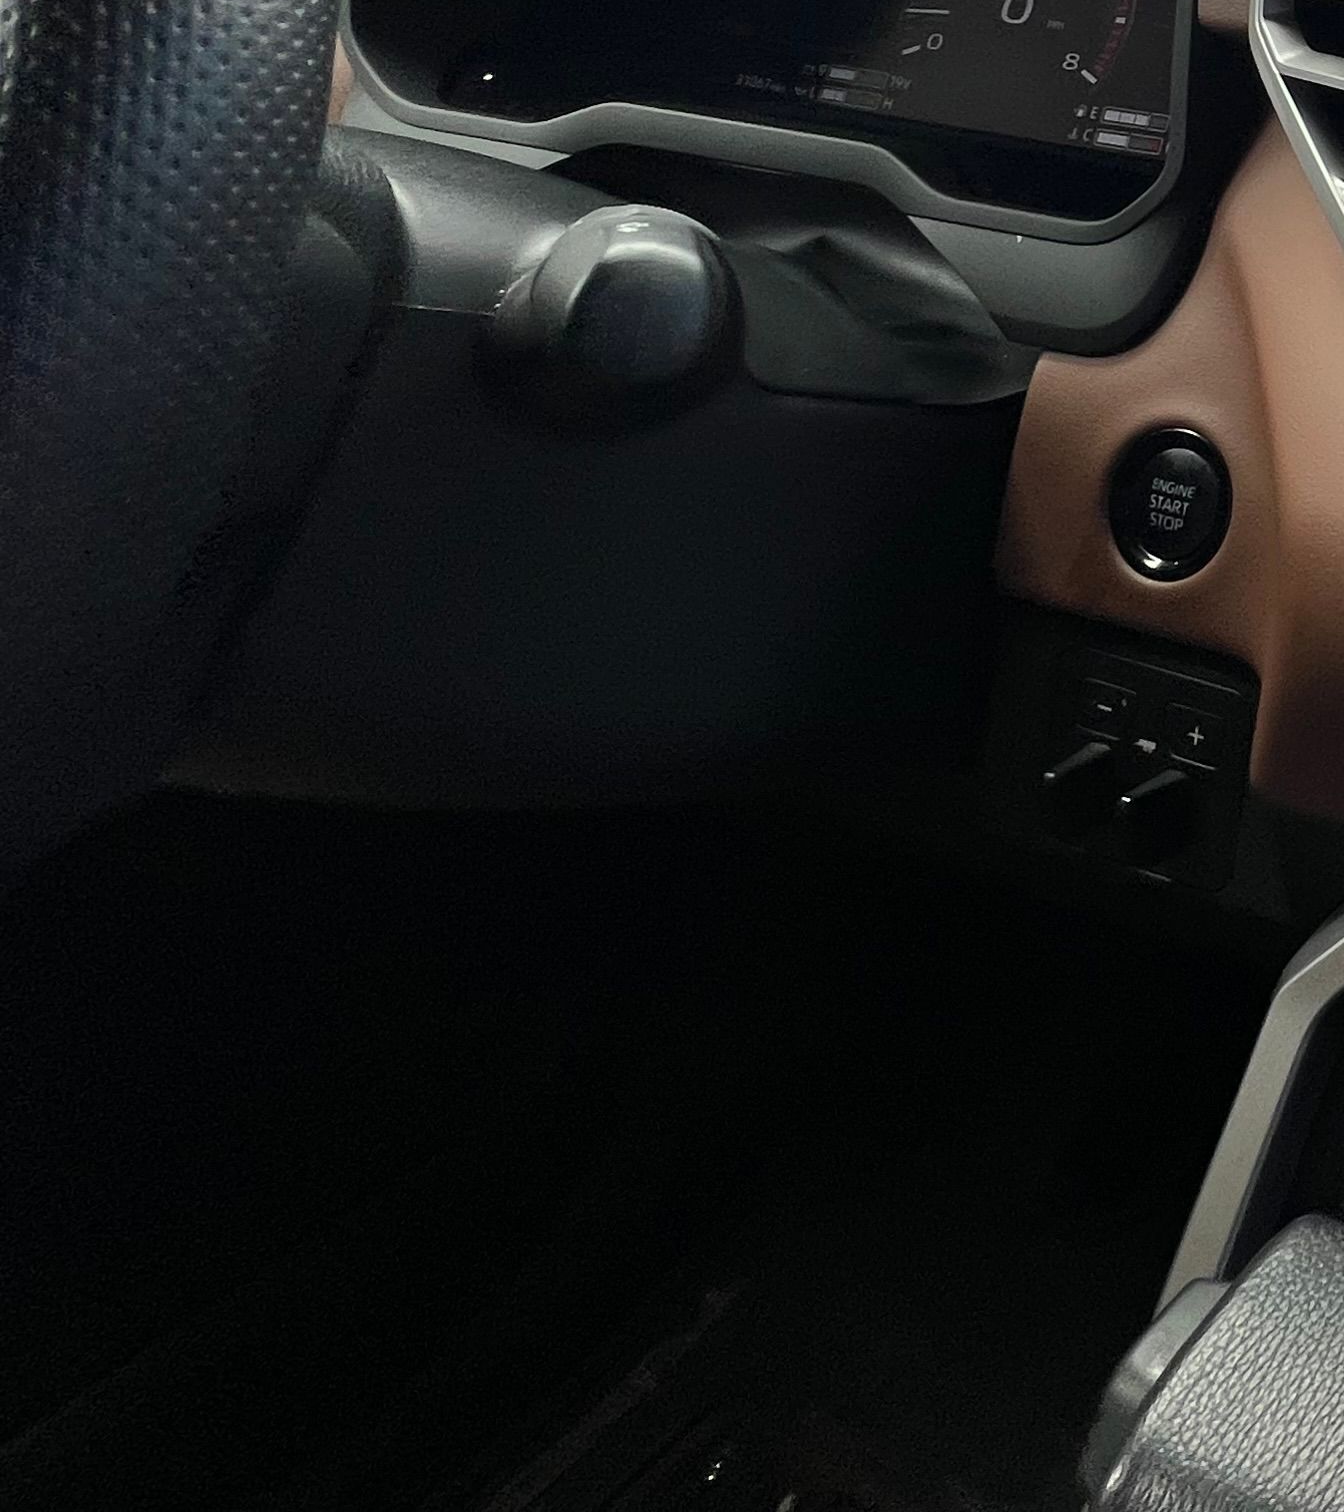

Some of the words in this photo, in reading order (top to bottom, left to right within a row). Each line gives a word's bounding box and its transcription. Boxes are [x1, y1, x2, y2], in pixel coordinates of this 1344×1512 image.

[926, 33, 944, 51] 0
[1062, 53, 1080, 71] 8
[1152, 477, 1197, 499] ENGINE
[1149, 494, 1190, 516] START
[1149, 511, 1184, 531] STOP
